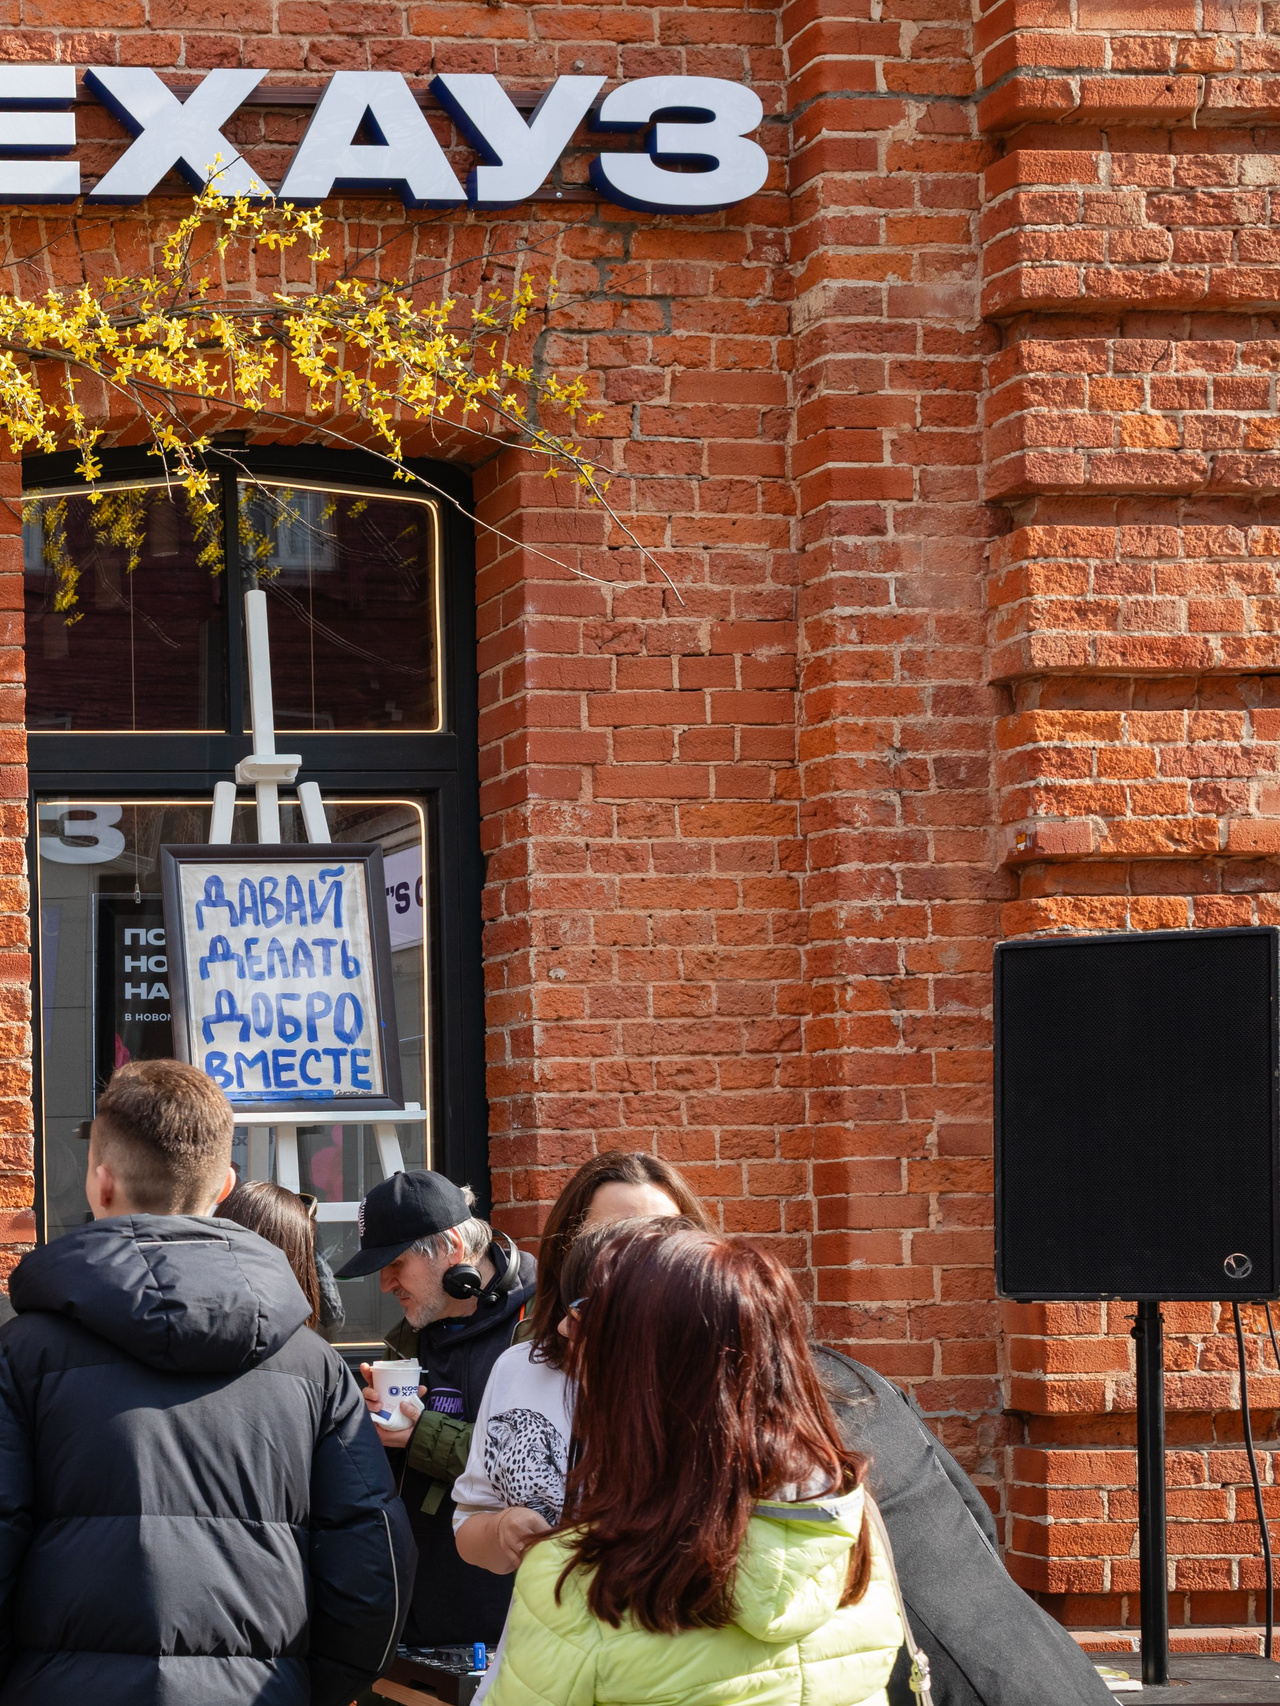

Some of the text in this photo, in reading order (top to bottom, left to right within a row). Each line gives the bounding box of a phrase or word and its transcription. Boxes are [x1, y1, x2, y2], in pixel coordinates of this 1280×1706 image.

[195, 865, 346, 931] ДАВАЙ
[199, 934, 361, 981] ДЕЛАТЬ
[124, 1013, 132, 1021] В
[201, 989, 364, 1046] ДОБРО
[204, 1047, 373, 1090] ВМЕСТЕ
